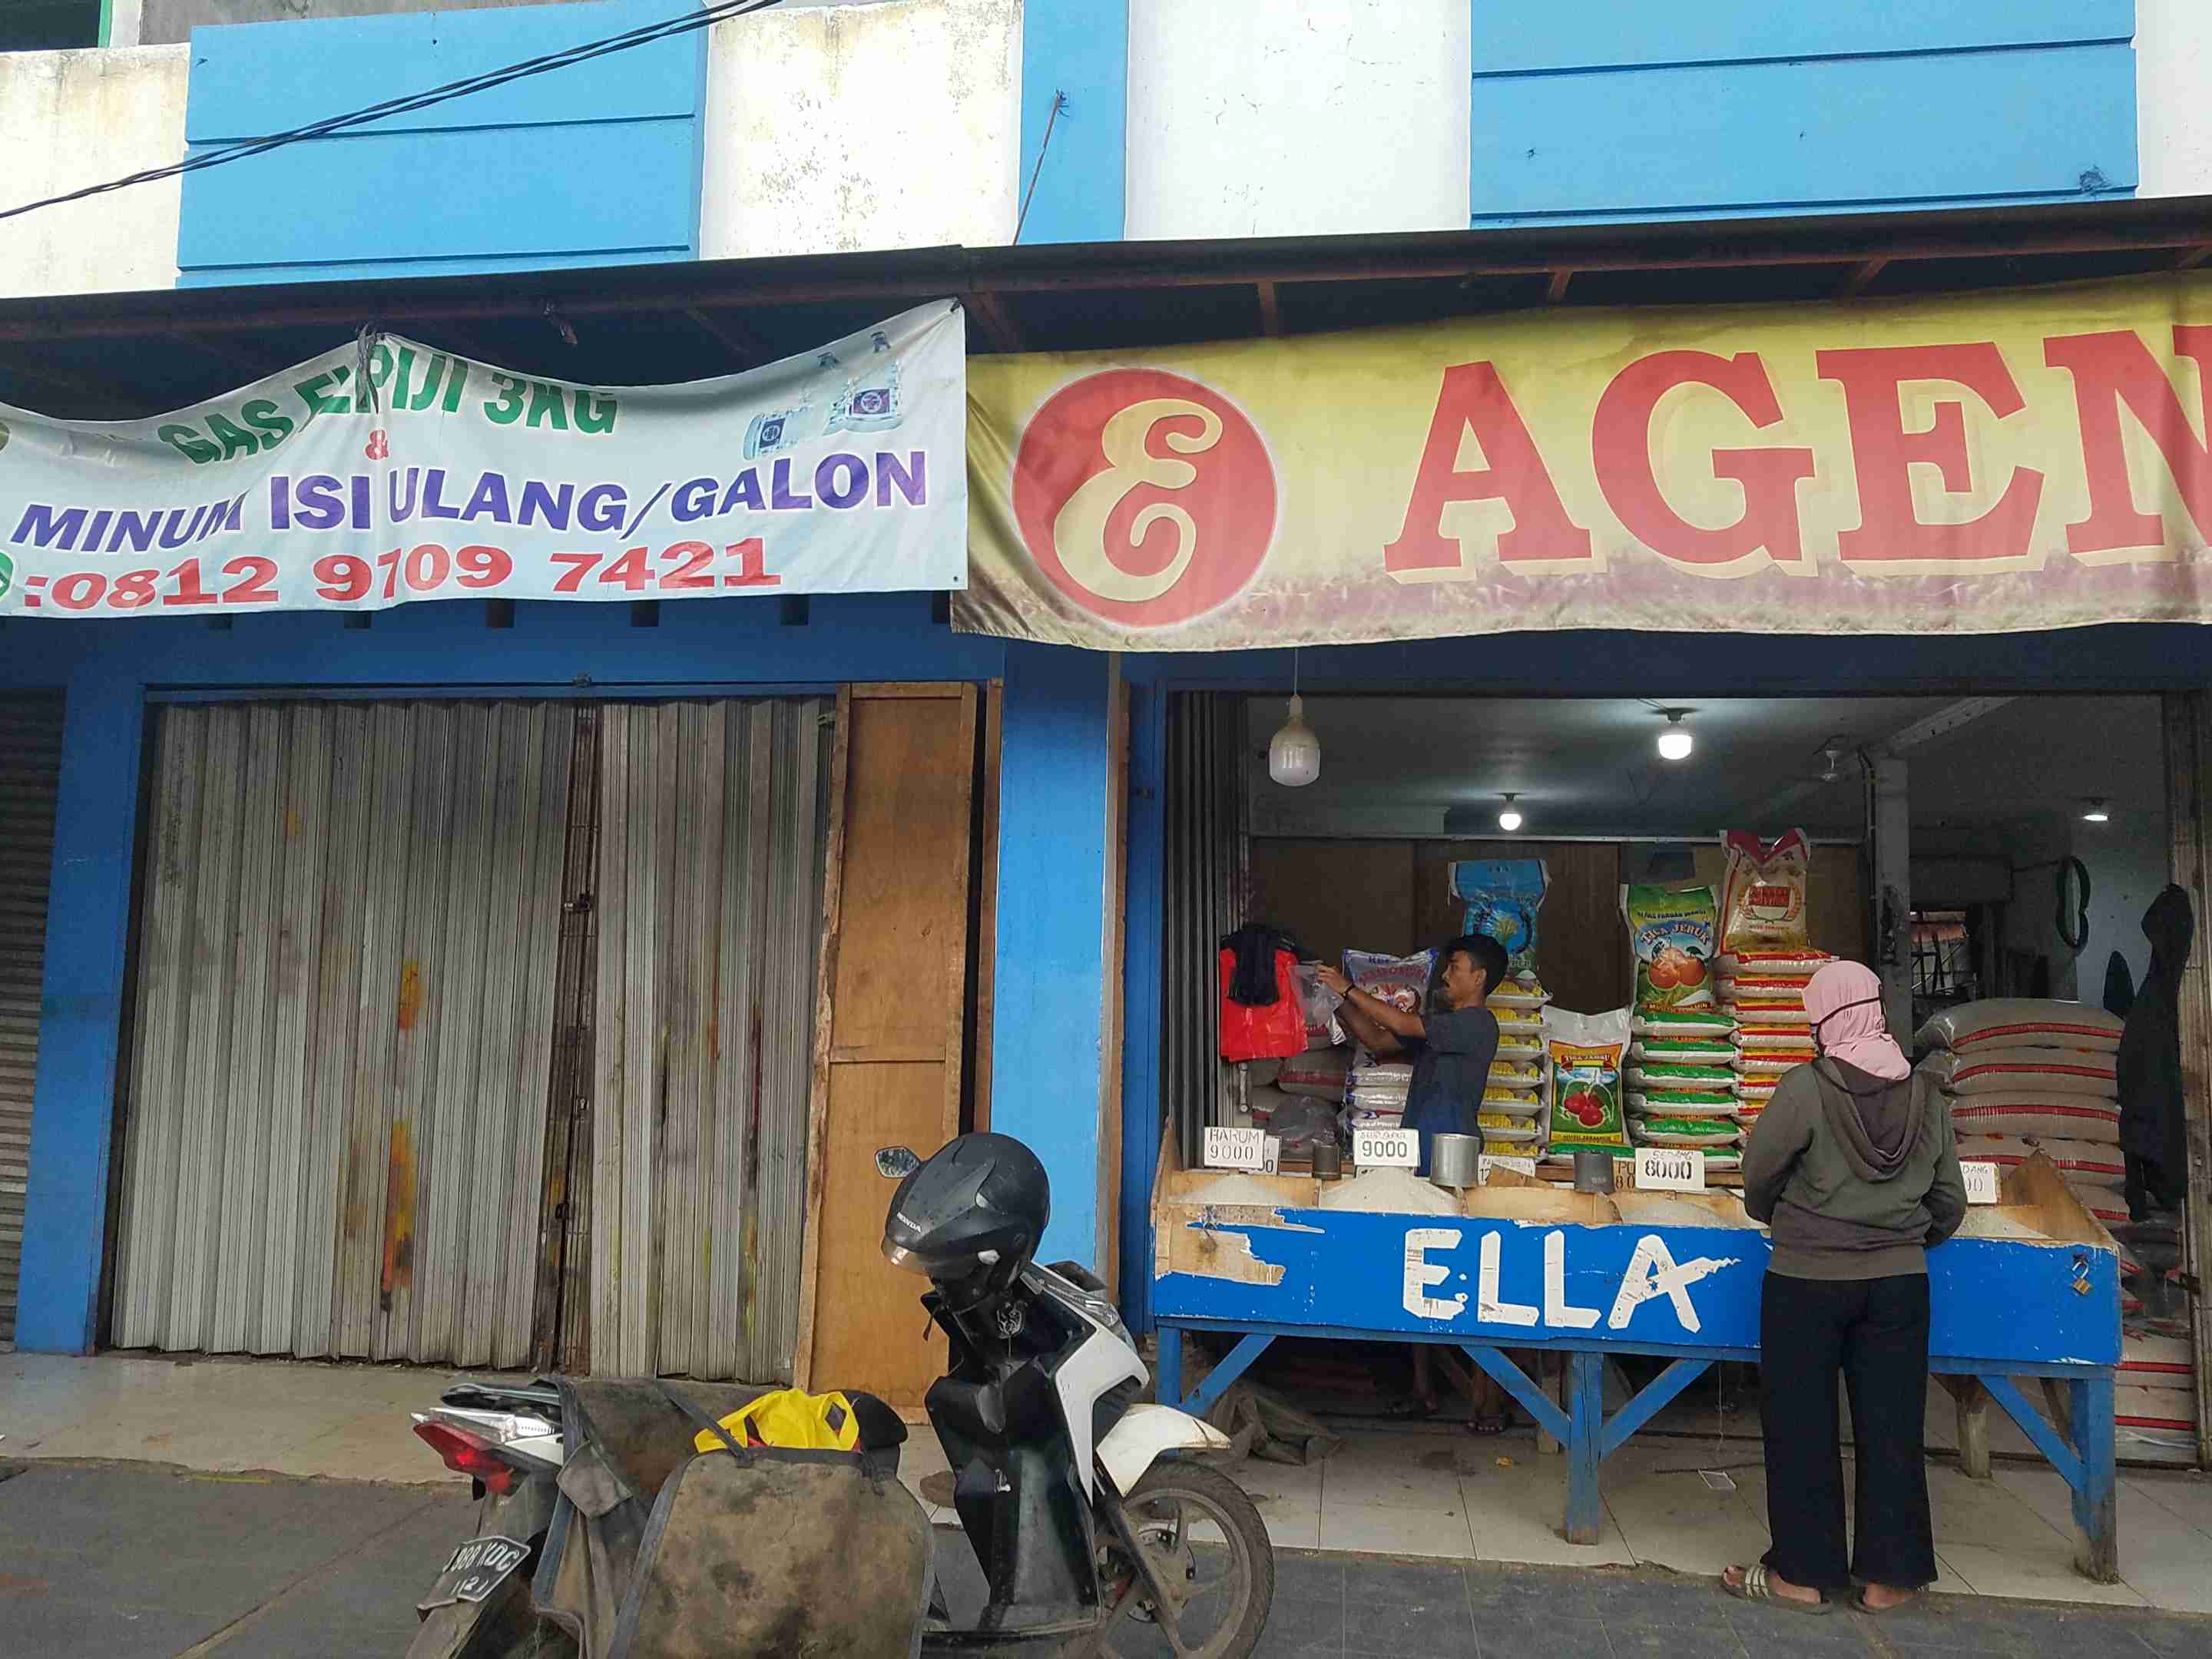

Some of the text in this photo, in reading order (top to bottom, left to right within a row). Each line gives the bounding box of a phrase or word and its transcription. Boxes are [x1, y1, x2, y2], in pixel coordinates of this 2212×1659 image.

[157, 398, 294, 464] GAS
[482, 372, 618, 435] 3KG
[1383, 323, 2212, 575] AGEN
[10, 489, 250, 552] MINUM
[270, 474, 370, 530] ISI
[549, 537, 782, 592] 7421
[1210, 1128, 1260, 1144] HARUM
[1210, 1144, 1253, 1161] 9000
[1362, 1141, 1408, 1158] 9000
[1645, 1160, 1692, 1180] 8000
[1403, 1228, 1743, 1333] ELLA
